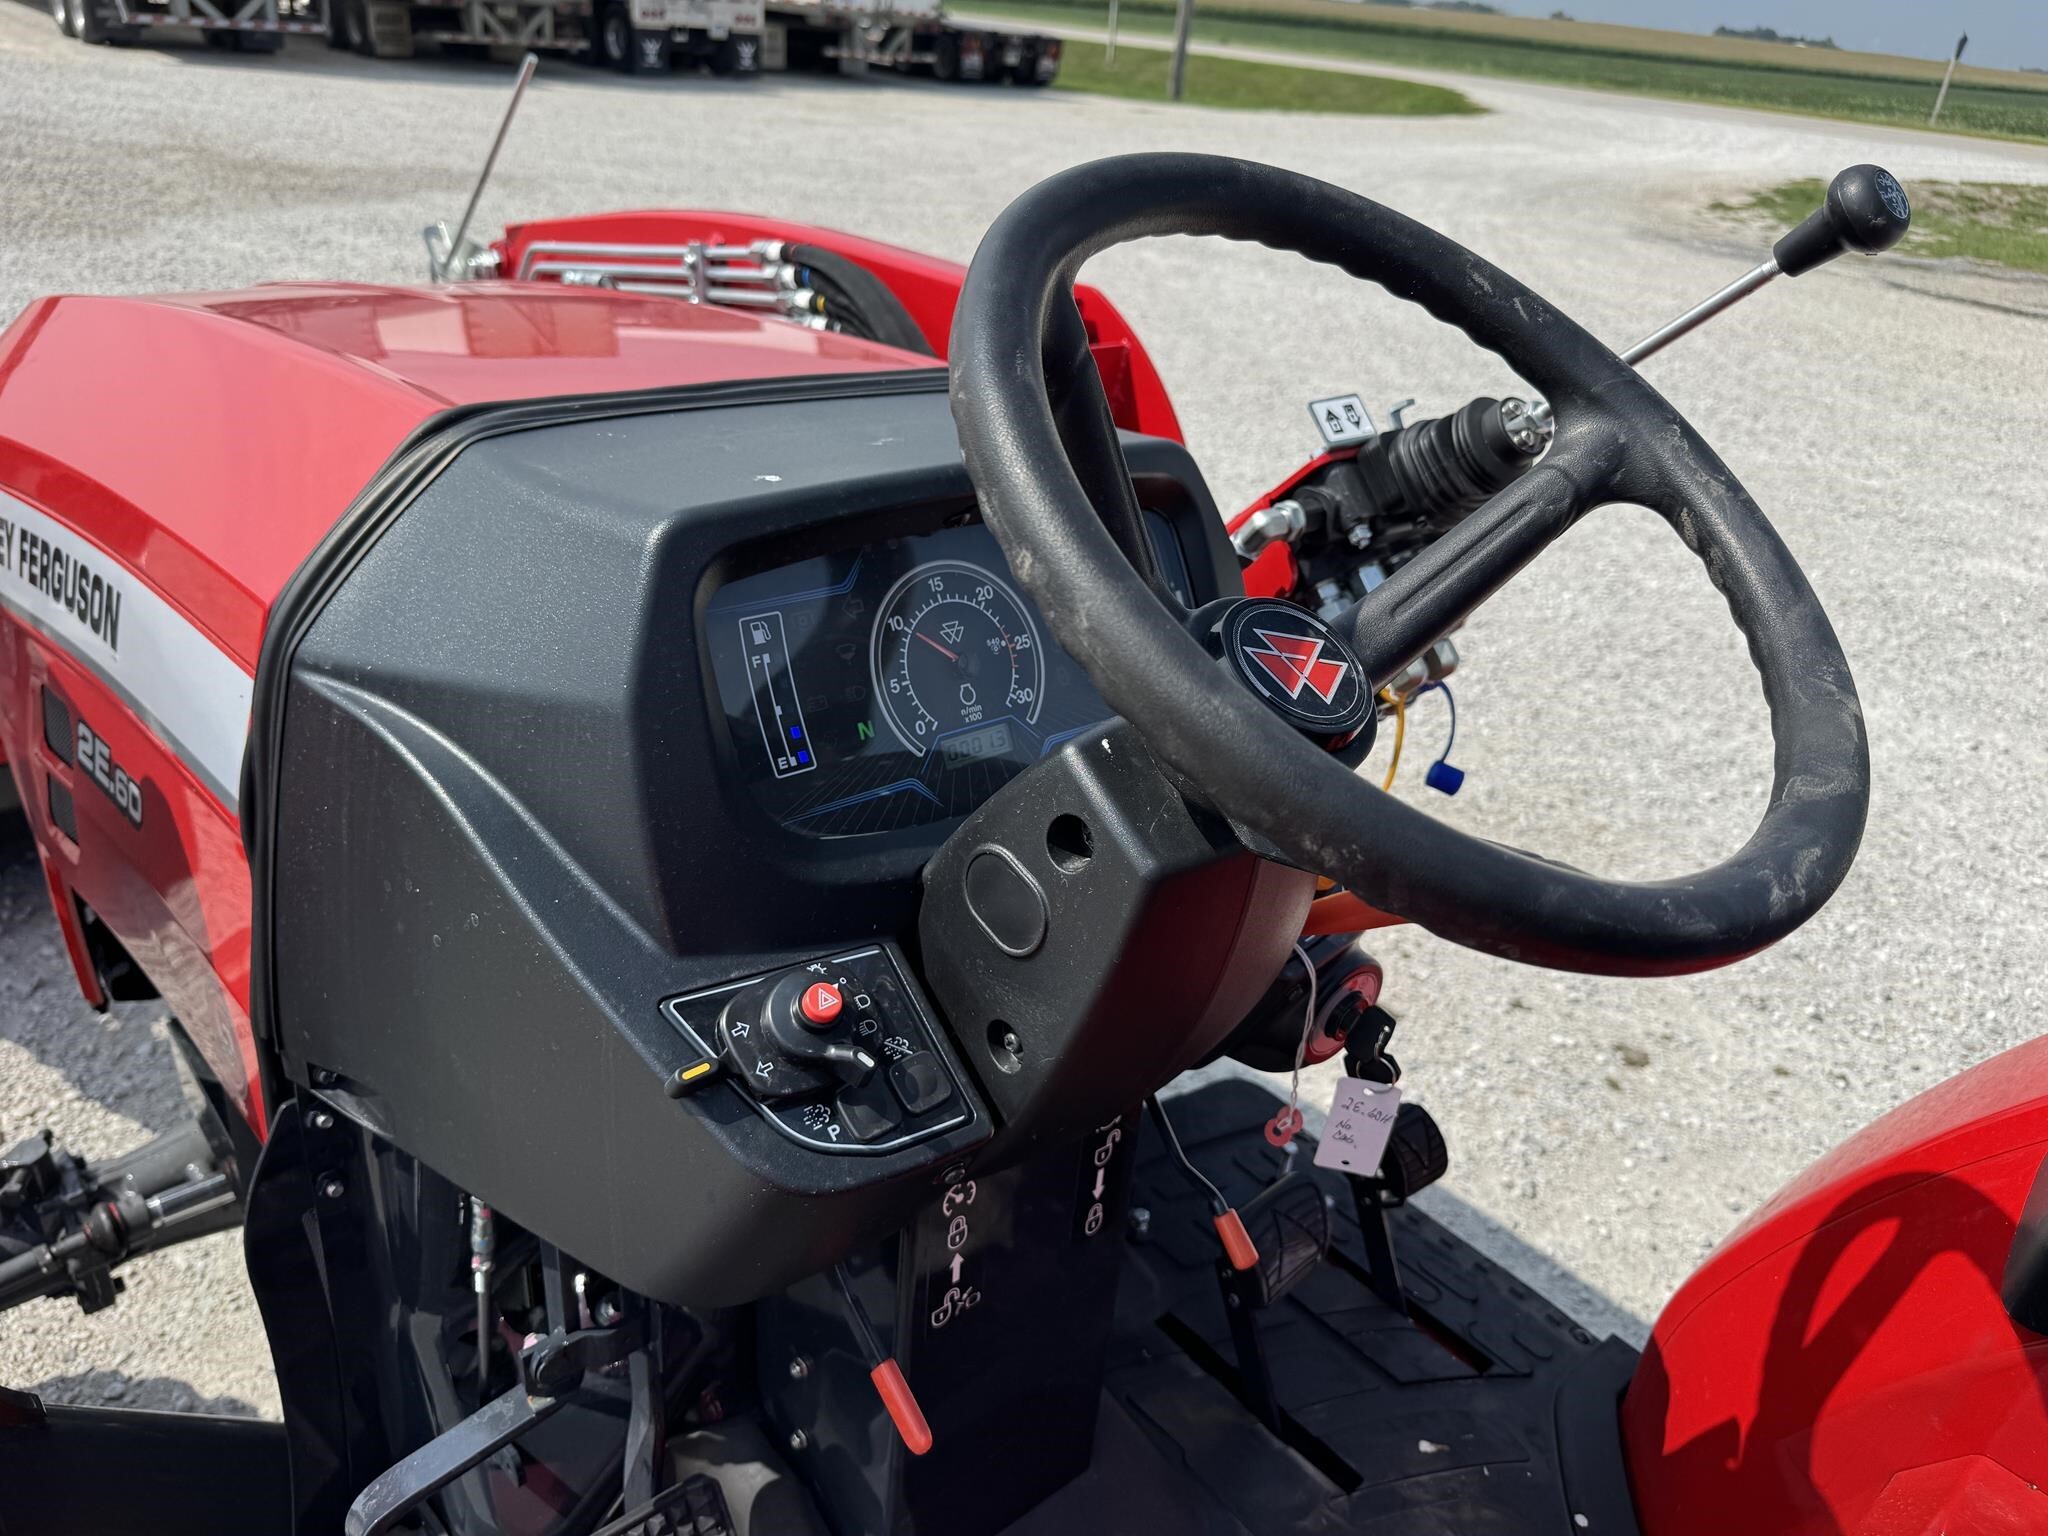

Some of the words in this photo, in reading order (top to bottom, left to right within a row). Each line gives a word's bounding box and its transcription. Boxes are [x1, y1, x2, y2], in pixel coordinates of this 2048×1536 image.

[20, 527, 122, 652] FERGUSON
[928, 576, 944, 592] 15
[975, 585, 994, 601] 20
[887, 615, 904, 631] 10
[1014, 634, 1031, 650] 25
[751, 655, 762, 668] F
[889, 678, 900, 693] 5
[1016, 688, 1033, 704] 30
[961, 703, 982, 716] n/min
[965, 711, 983, 723] x100
[857, 720, 875, 741] N
[915, 720, 926, 735] 0
[777, 757, 789, 770] E
[77, 720, 143, 826] 2E.60
[827, 1124, 841, 1142] P
